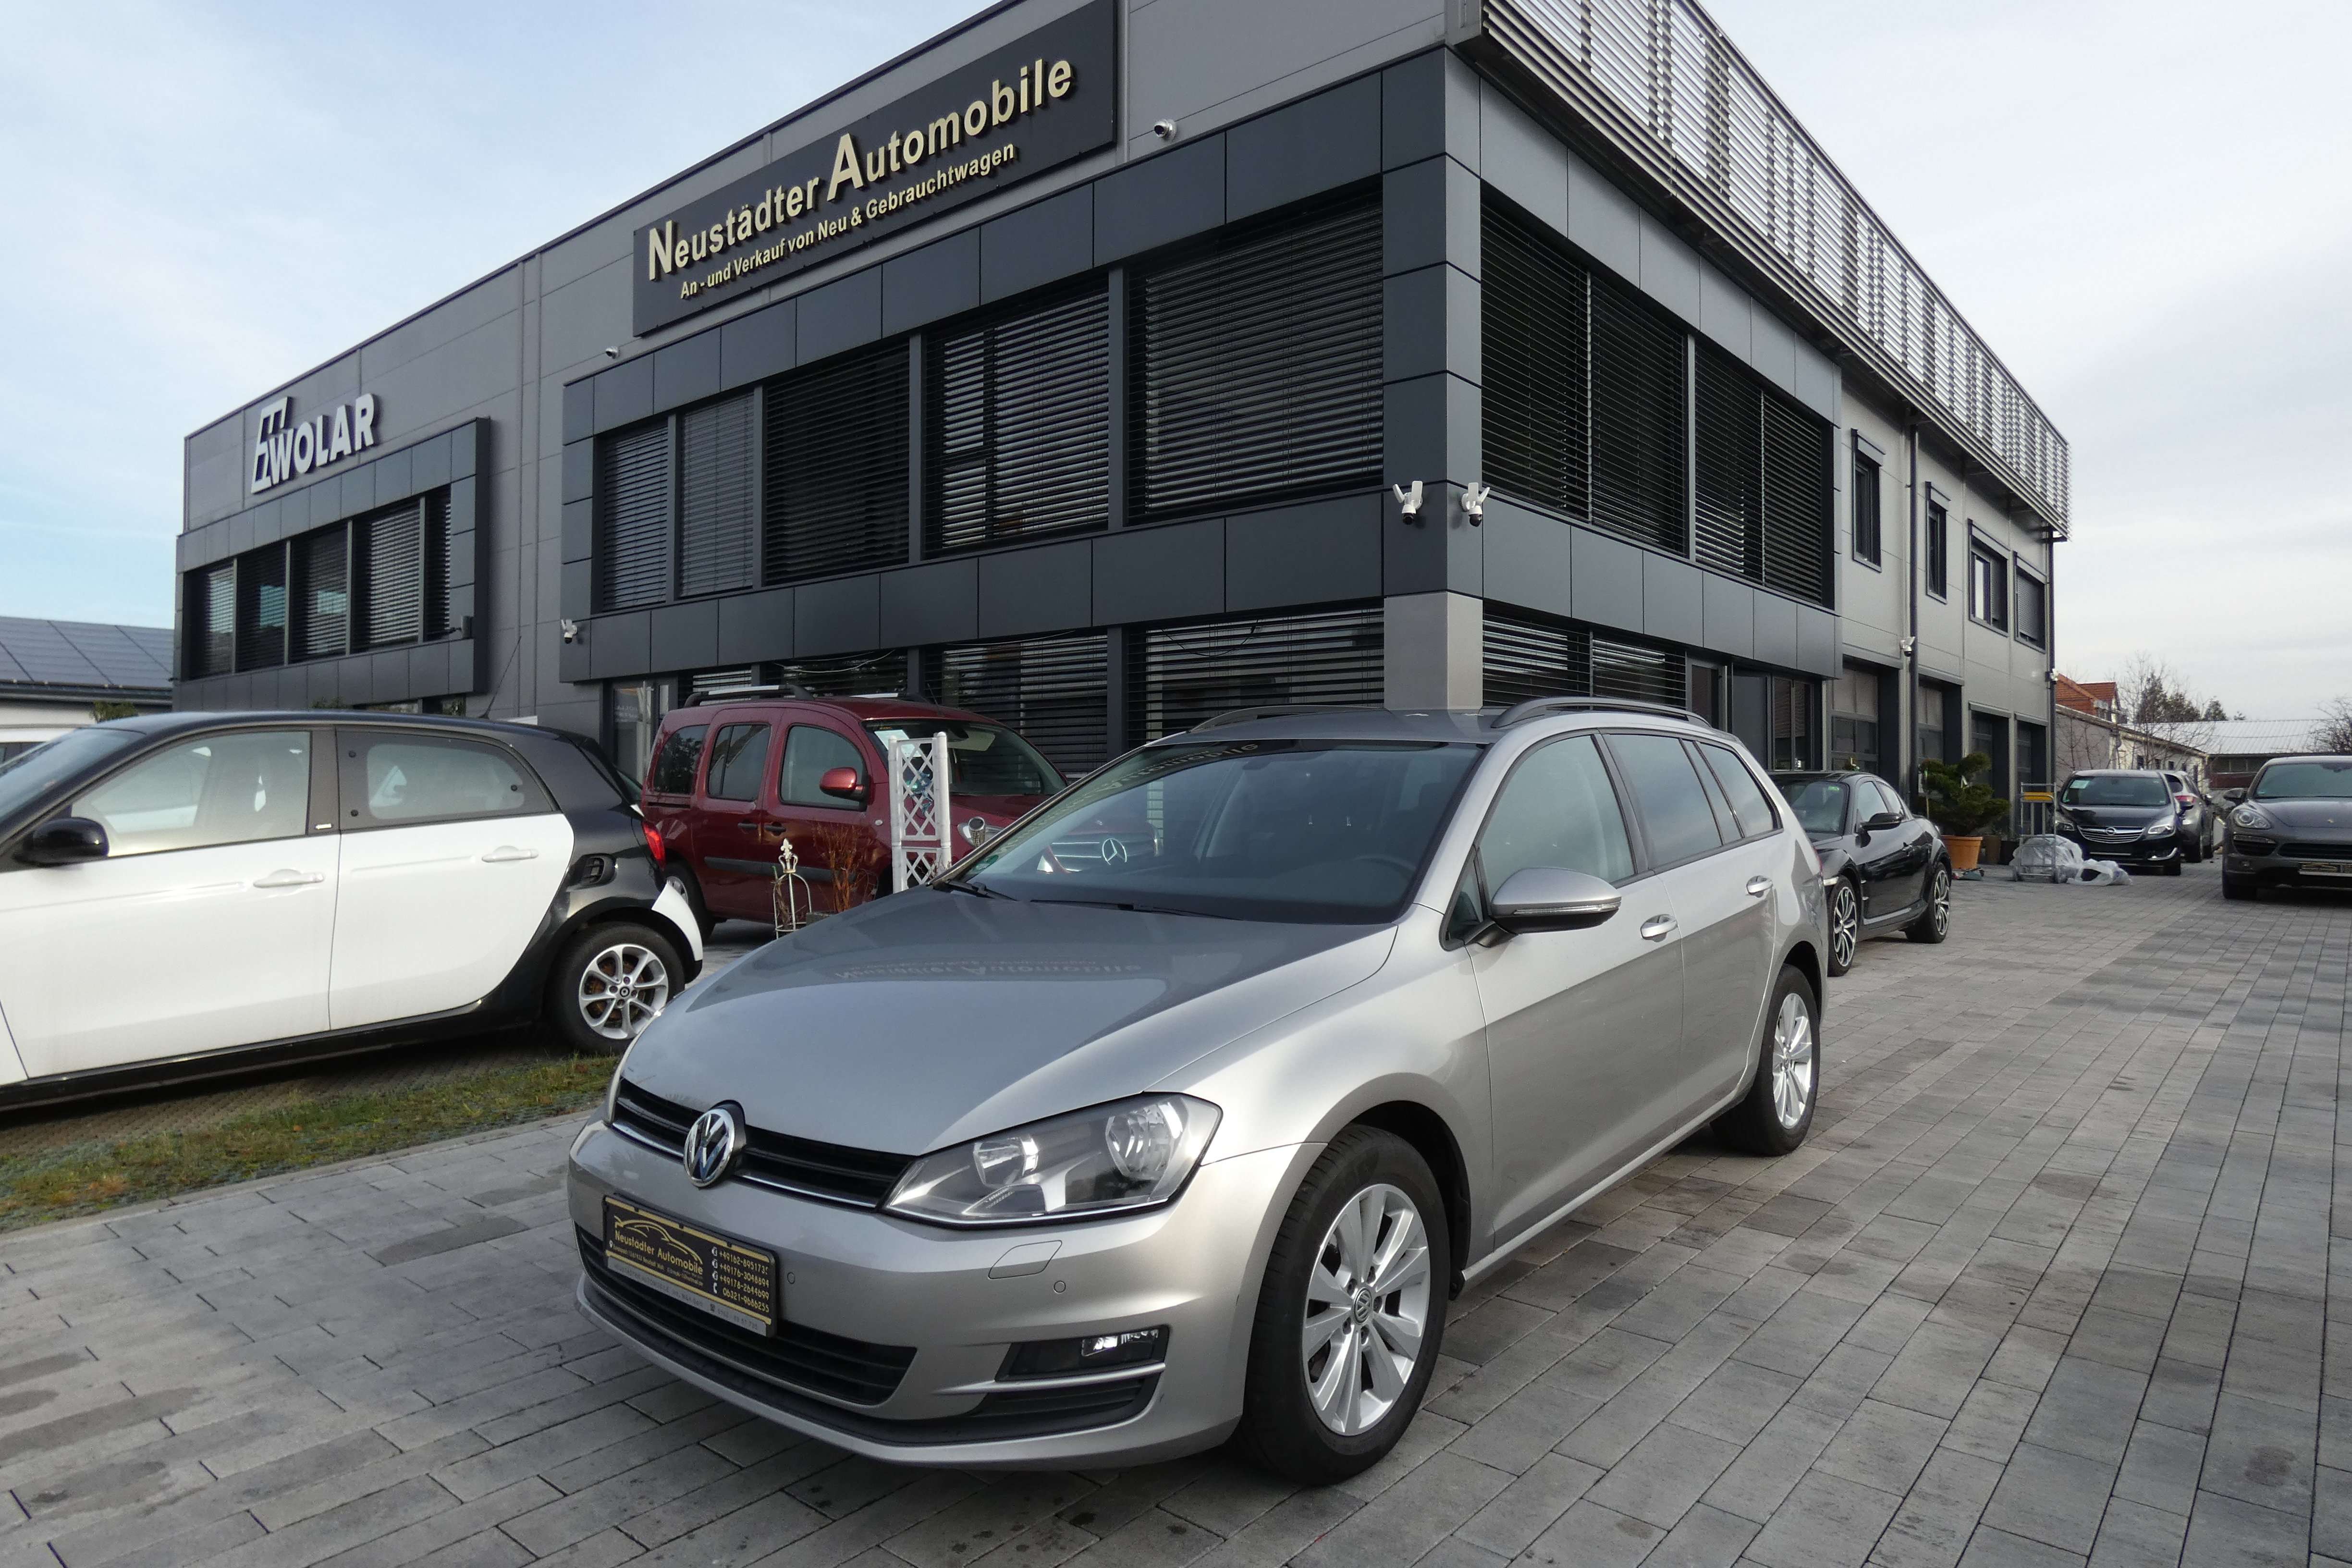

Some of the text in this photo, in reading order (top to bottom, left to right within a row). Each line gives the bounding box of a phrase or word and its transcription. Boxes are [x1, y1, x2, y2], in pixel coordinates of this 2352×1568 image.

[649, 58, 1072, 280] Neustädter Automobile
[681, 282, 697, 299] An
[708, 262, 731, 287] und
[734, 239, 785, 275] Verkauf
[788, 230, 814, 253] von
[818, 216, 847, 241] Neu
[851, 207, 862, 227] &
[866, 144, 1014, 220] Gebrauchtwagen
[657, 1248, 703, 1275] Automobile
